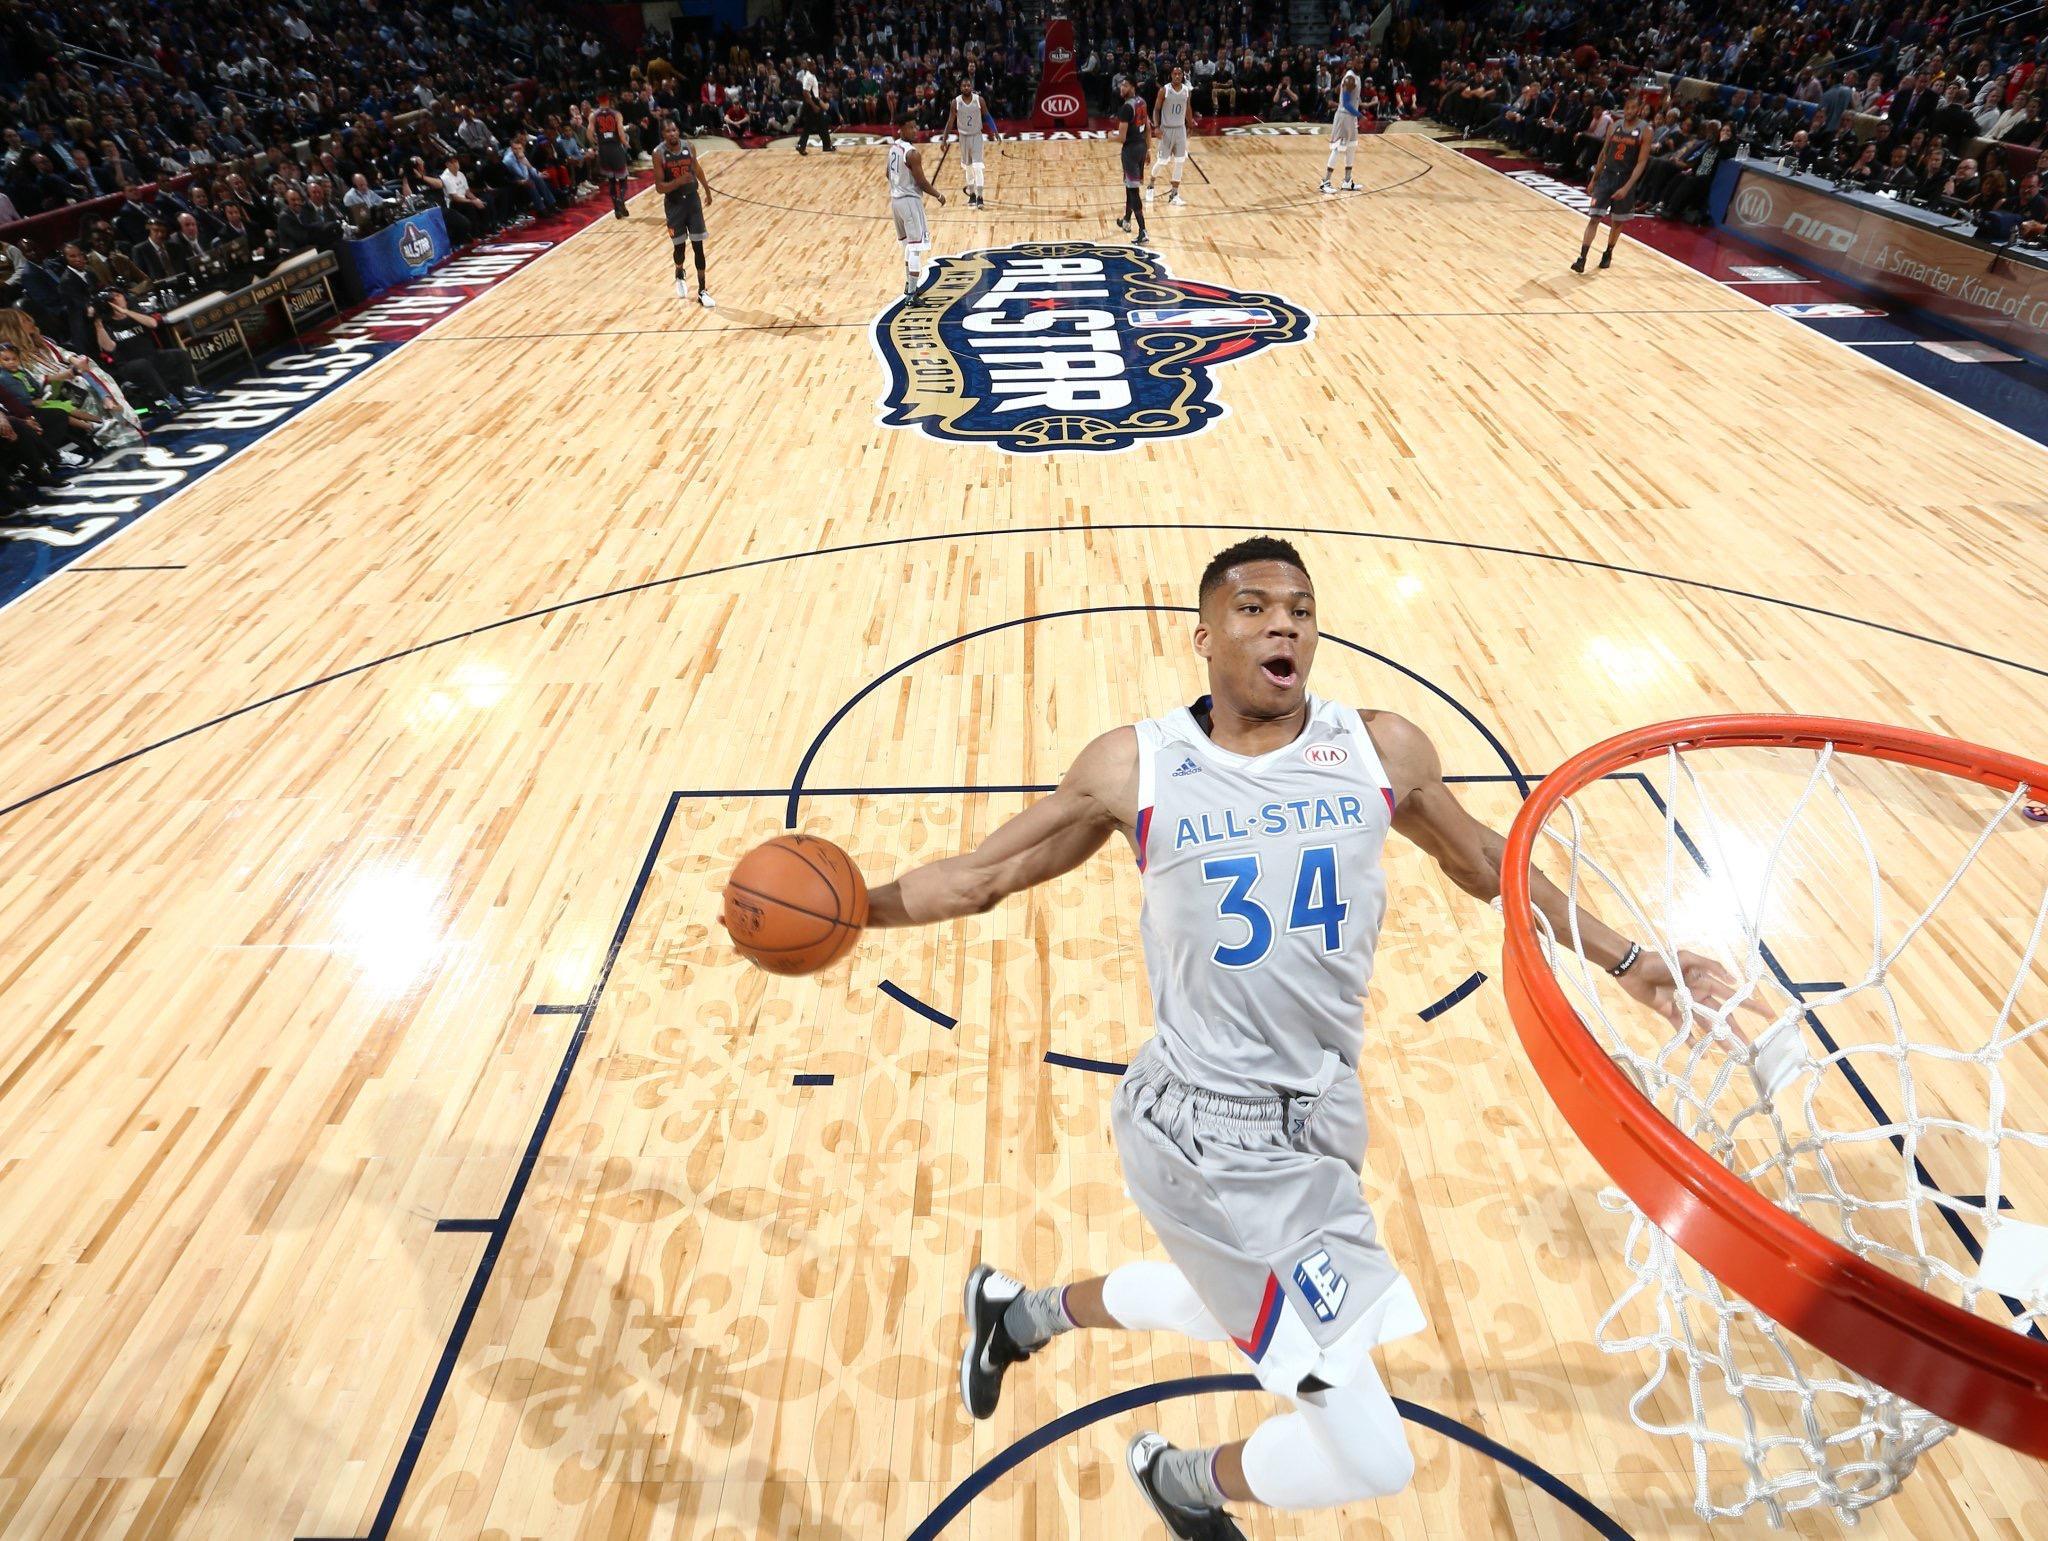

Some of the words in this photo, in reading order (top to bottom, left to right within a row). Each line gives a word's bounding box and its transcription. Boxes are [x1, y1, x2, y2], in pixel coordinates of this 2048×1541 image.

[1047, 99, 1073, 112] KIA
[1171, 103, 1182, 114] 10
[966, 115, 973, 127] 2
[1221, 127, 1321, 136] 2017
[890, 151, 900, 174] 21
[1740, 193, 1766, 217] KIA
[1783, 212, 1858, 252] niro
[936, 270, 977, 291] NEW
[1875, 246, 1889, 265] A
[1892, 252, 1957, 292] Smarter
[1959, 275, 2001, 310] Kind
[2002, 296, 2027, 319] of
[291, 285, 324, 312] SUNDAY
[213, 329, 238, 353] STAR
[962, 309, 1133, 413] STAR
[911, 358, 956, 394] 2017
[1311, 750, 1338, 763] KIA
[1172, 766, 1203, 777] adidas
[1201, 843, 1351, 973] 34
